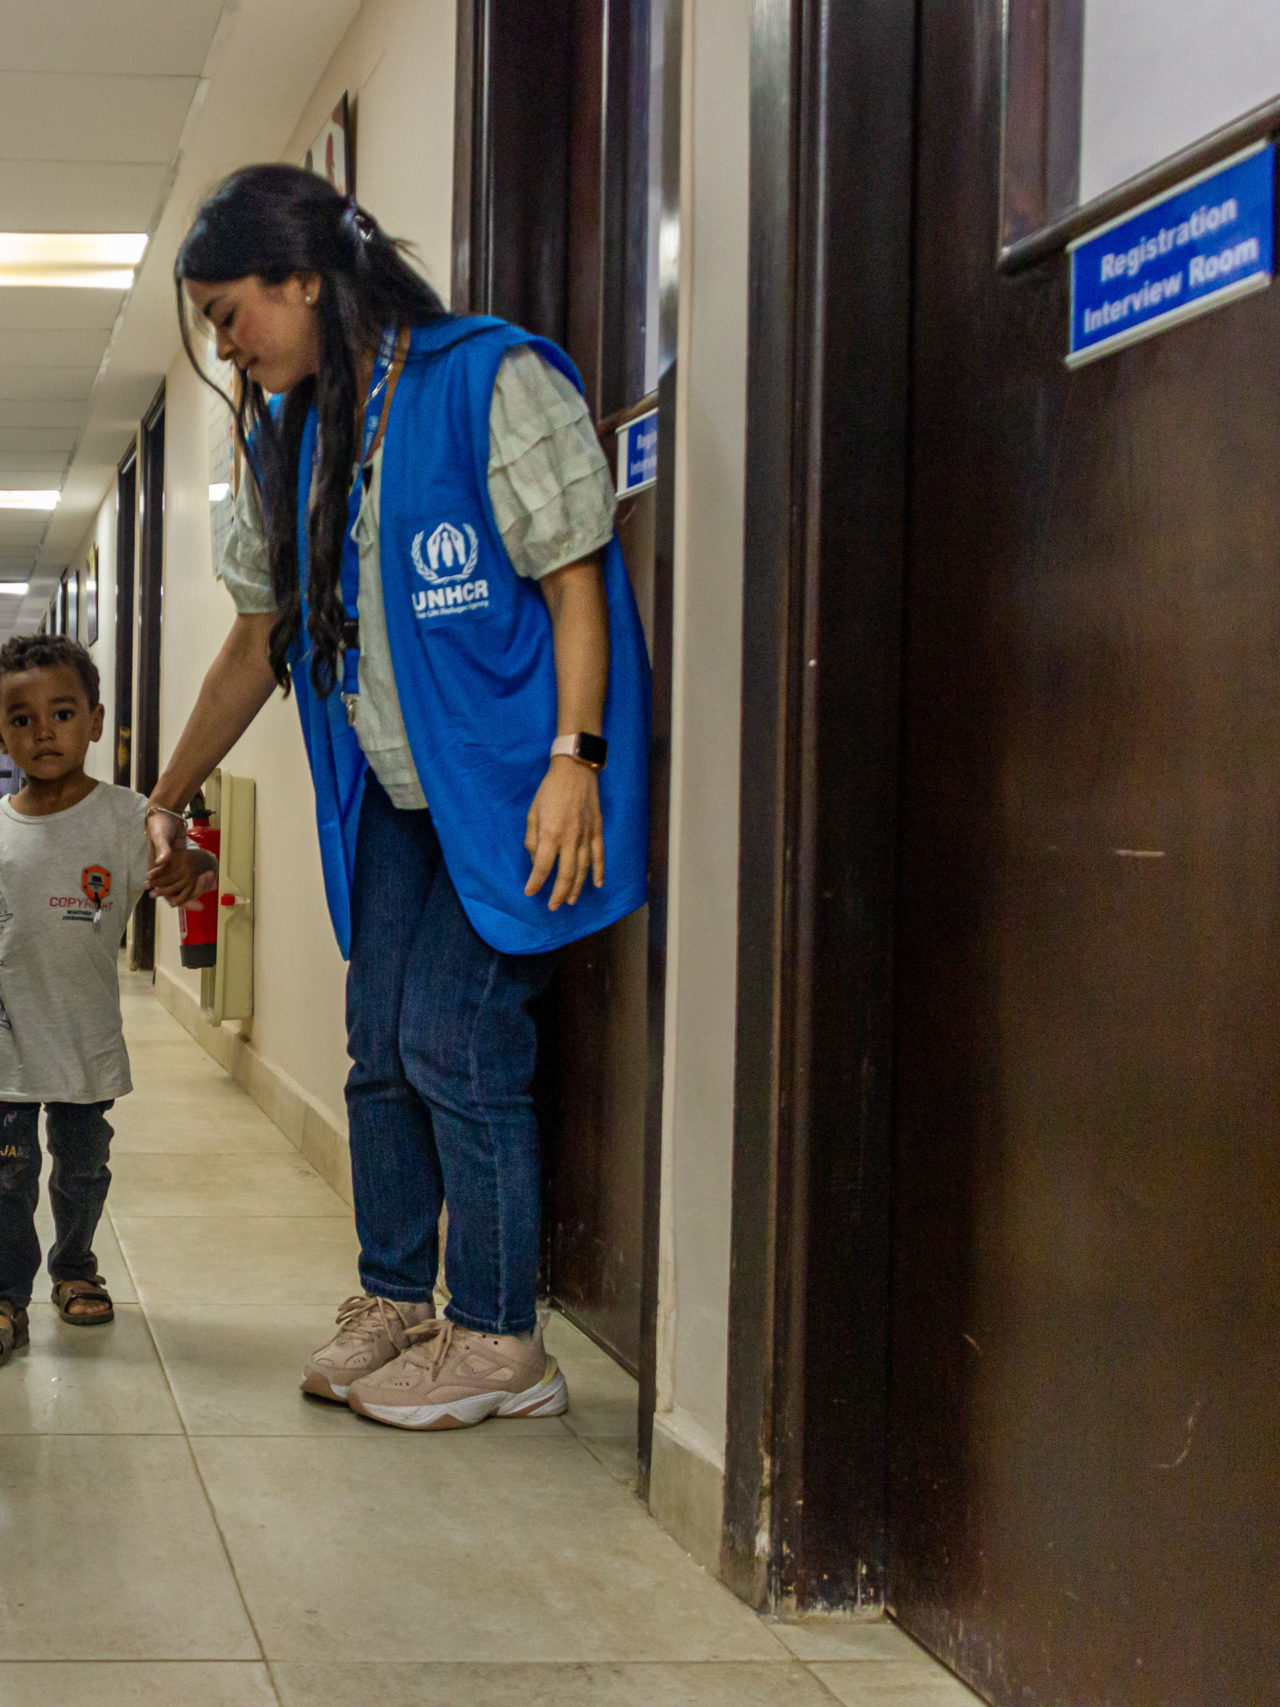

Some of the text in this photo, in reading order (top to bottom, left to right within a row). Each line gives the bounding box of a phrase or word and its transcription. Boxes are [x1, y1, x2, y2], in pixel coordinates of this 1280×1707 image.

[1100, 198, 1238, 283] Registration
[1084, 237, 1260, 335] Interview Room
[411, 579, 489, 611] UNHCR
